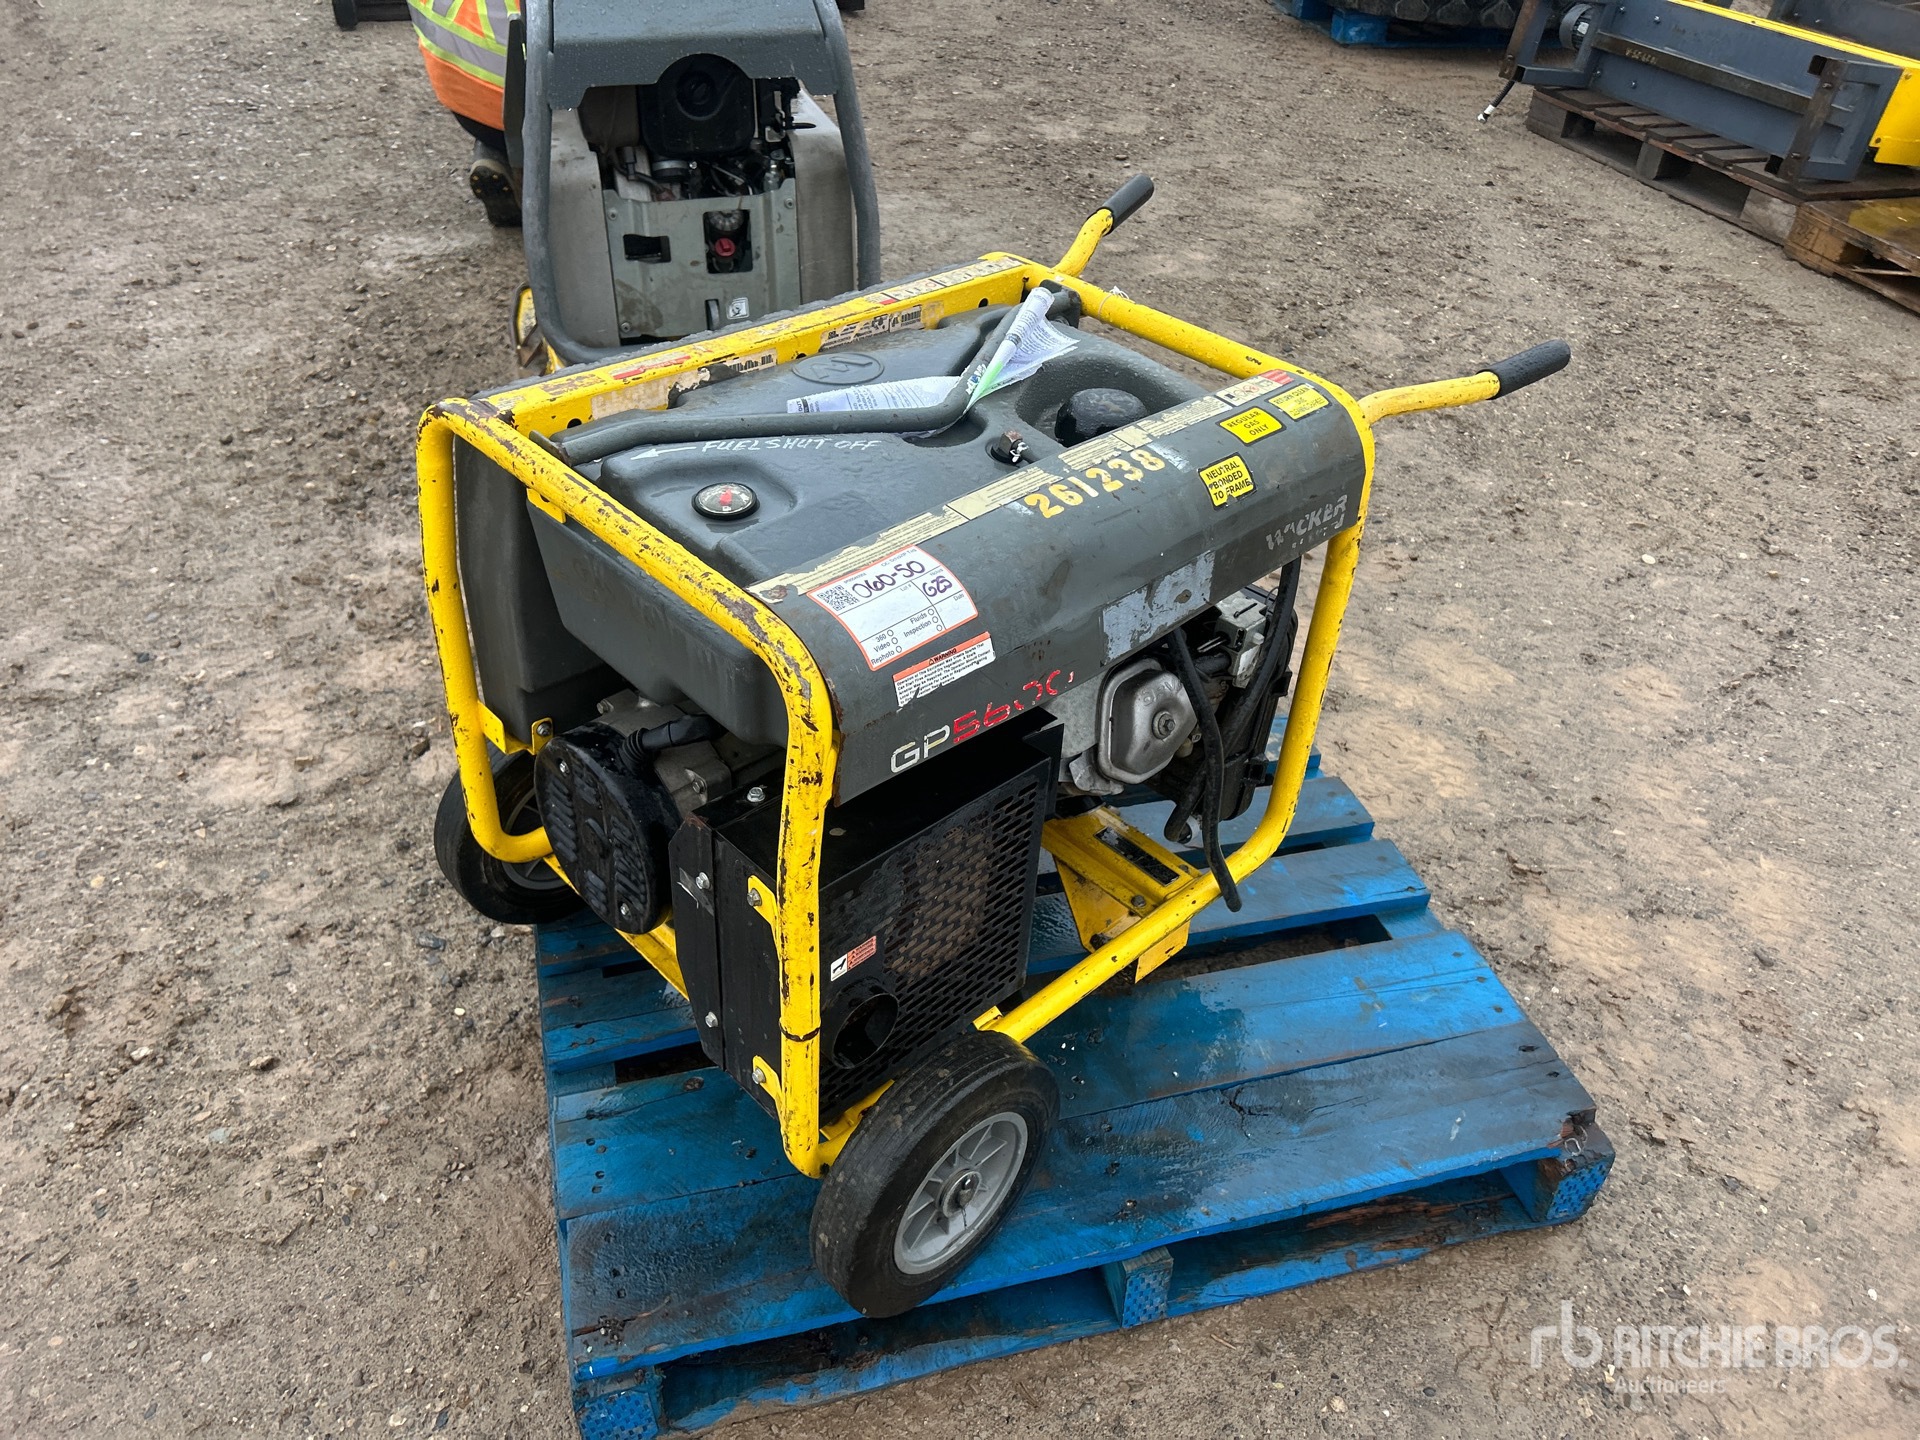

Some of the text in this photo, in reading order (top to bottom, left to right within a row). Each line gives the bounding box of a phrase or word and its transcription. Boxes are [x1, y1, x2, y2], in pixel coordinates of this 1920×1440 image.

[1227, 411, 1261, 428] REGULAR
[1243, 419, 1260, 430] GAS
[1249, 424, 1269, 436] ONLY
[702, 437, 882, 453] FUEL SHUT OFF
[1206, 460, 1240, 480] NEUTRAL
[1024, 449, 1166, 519] 261238
[1213, 470, 1243, 490] BONDED
[1226, 478, 1251, 496] FRAME
[1213, 490, 1224, 500] TO
[910, 612, 928, 625] Fluids
[904, 621, 932, 638] Inspection
[875, 633, 887, 643] 360
[874, 641, 891, 653] Video
[934, 647, 957, 662] WARNING
[871, 650, 895, 665] Rephoto
